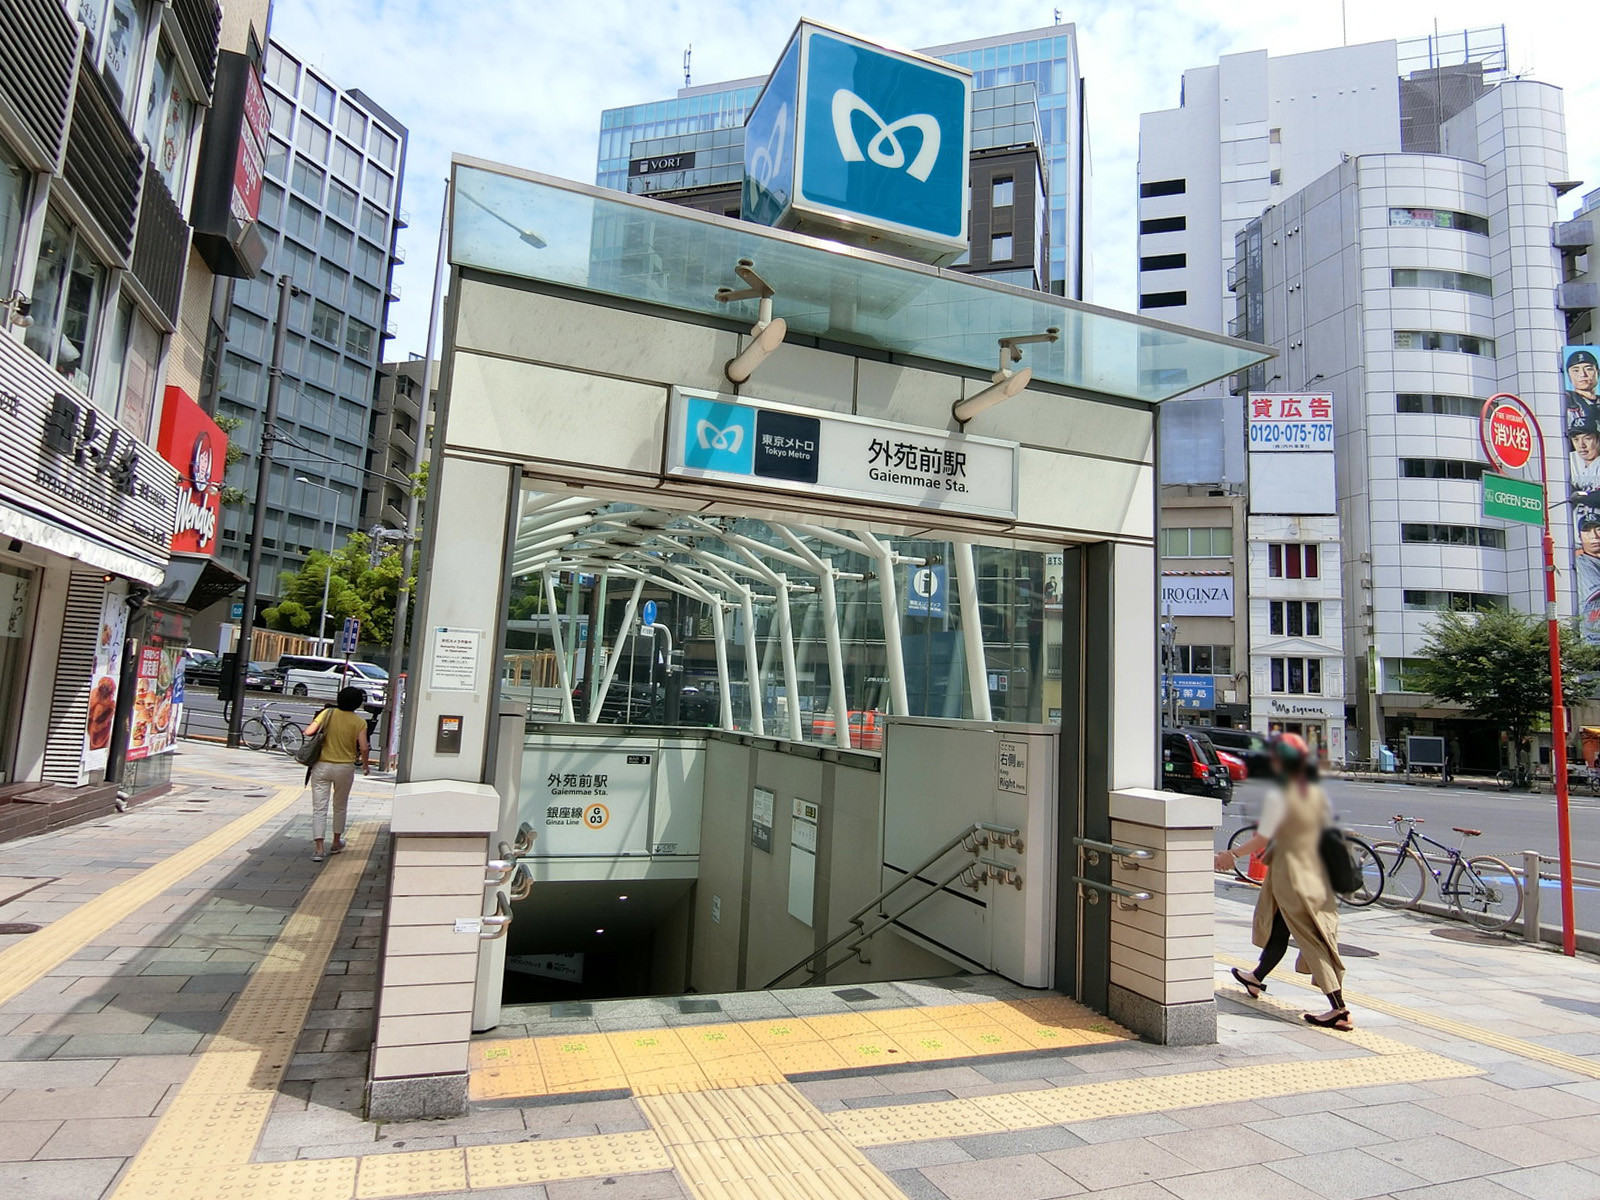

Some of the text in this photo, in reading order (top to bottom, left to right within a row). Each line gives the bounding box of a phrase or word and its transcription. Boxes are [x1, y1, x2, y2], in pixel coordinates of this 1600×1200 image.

[651, 157, 683, 170] VORT
[1251, 397, 1332, 419] 貸広告
[1250, 423, 1333, 443] 0120-075-787
[1493, 421, 1529, 451] 消火栓
[761, 433, 814, 452] 東京メトロ
[764, 447, 812, 461] Tokyo Metro
[868, 437, 967, 478] 外苑前駅
[868, 468, 969, 493] Gaiemmae Sta.
[1494, 491, 1542, 511] GREEN SEED
[174, 486, 216, 548] Wendy's
[1047, 556, 1062, 566] BTS
[1186, 588, 1229, 601] GINZA
[641, 756, 647, 764] 3
[547, 773, 608, 788] 外苑前駅
[551, 788, 608, 796] Gaiemmae Sta.
[546, 806, 583, 819] 銀座線
[593, 807, 601, 815] G
[590, 816, 603, 824] 03
